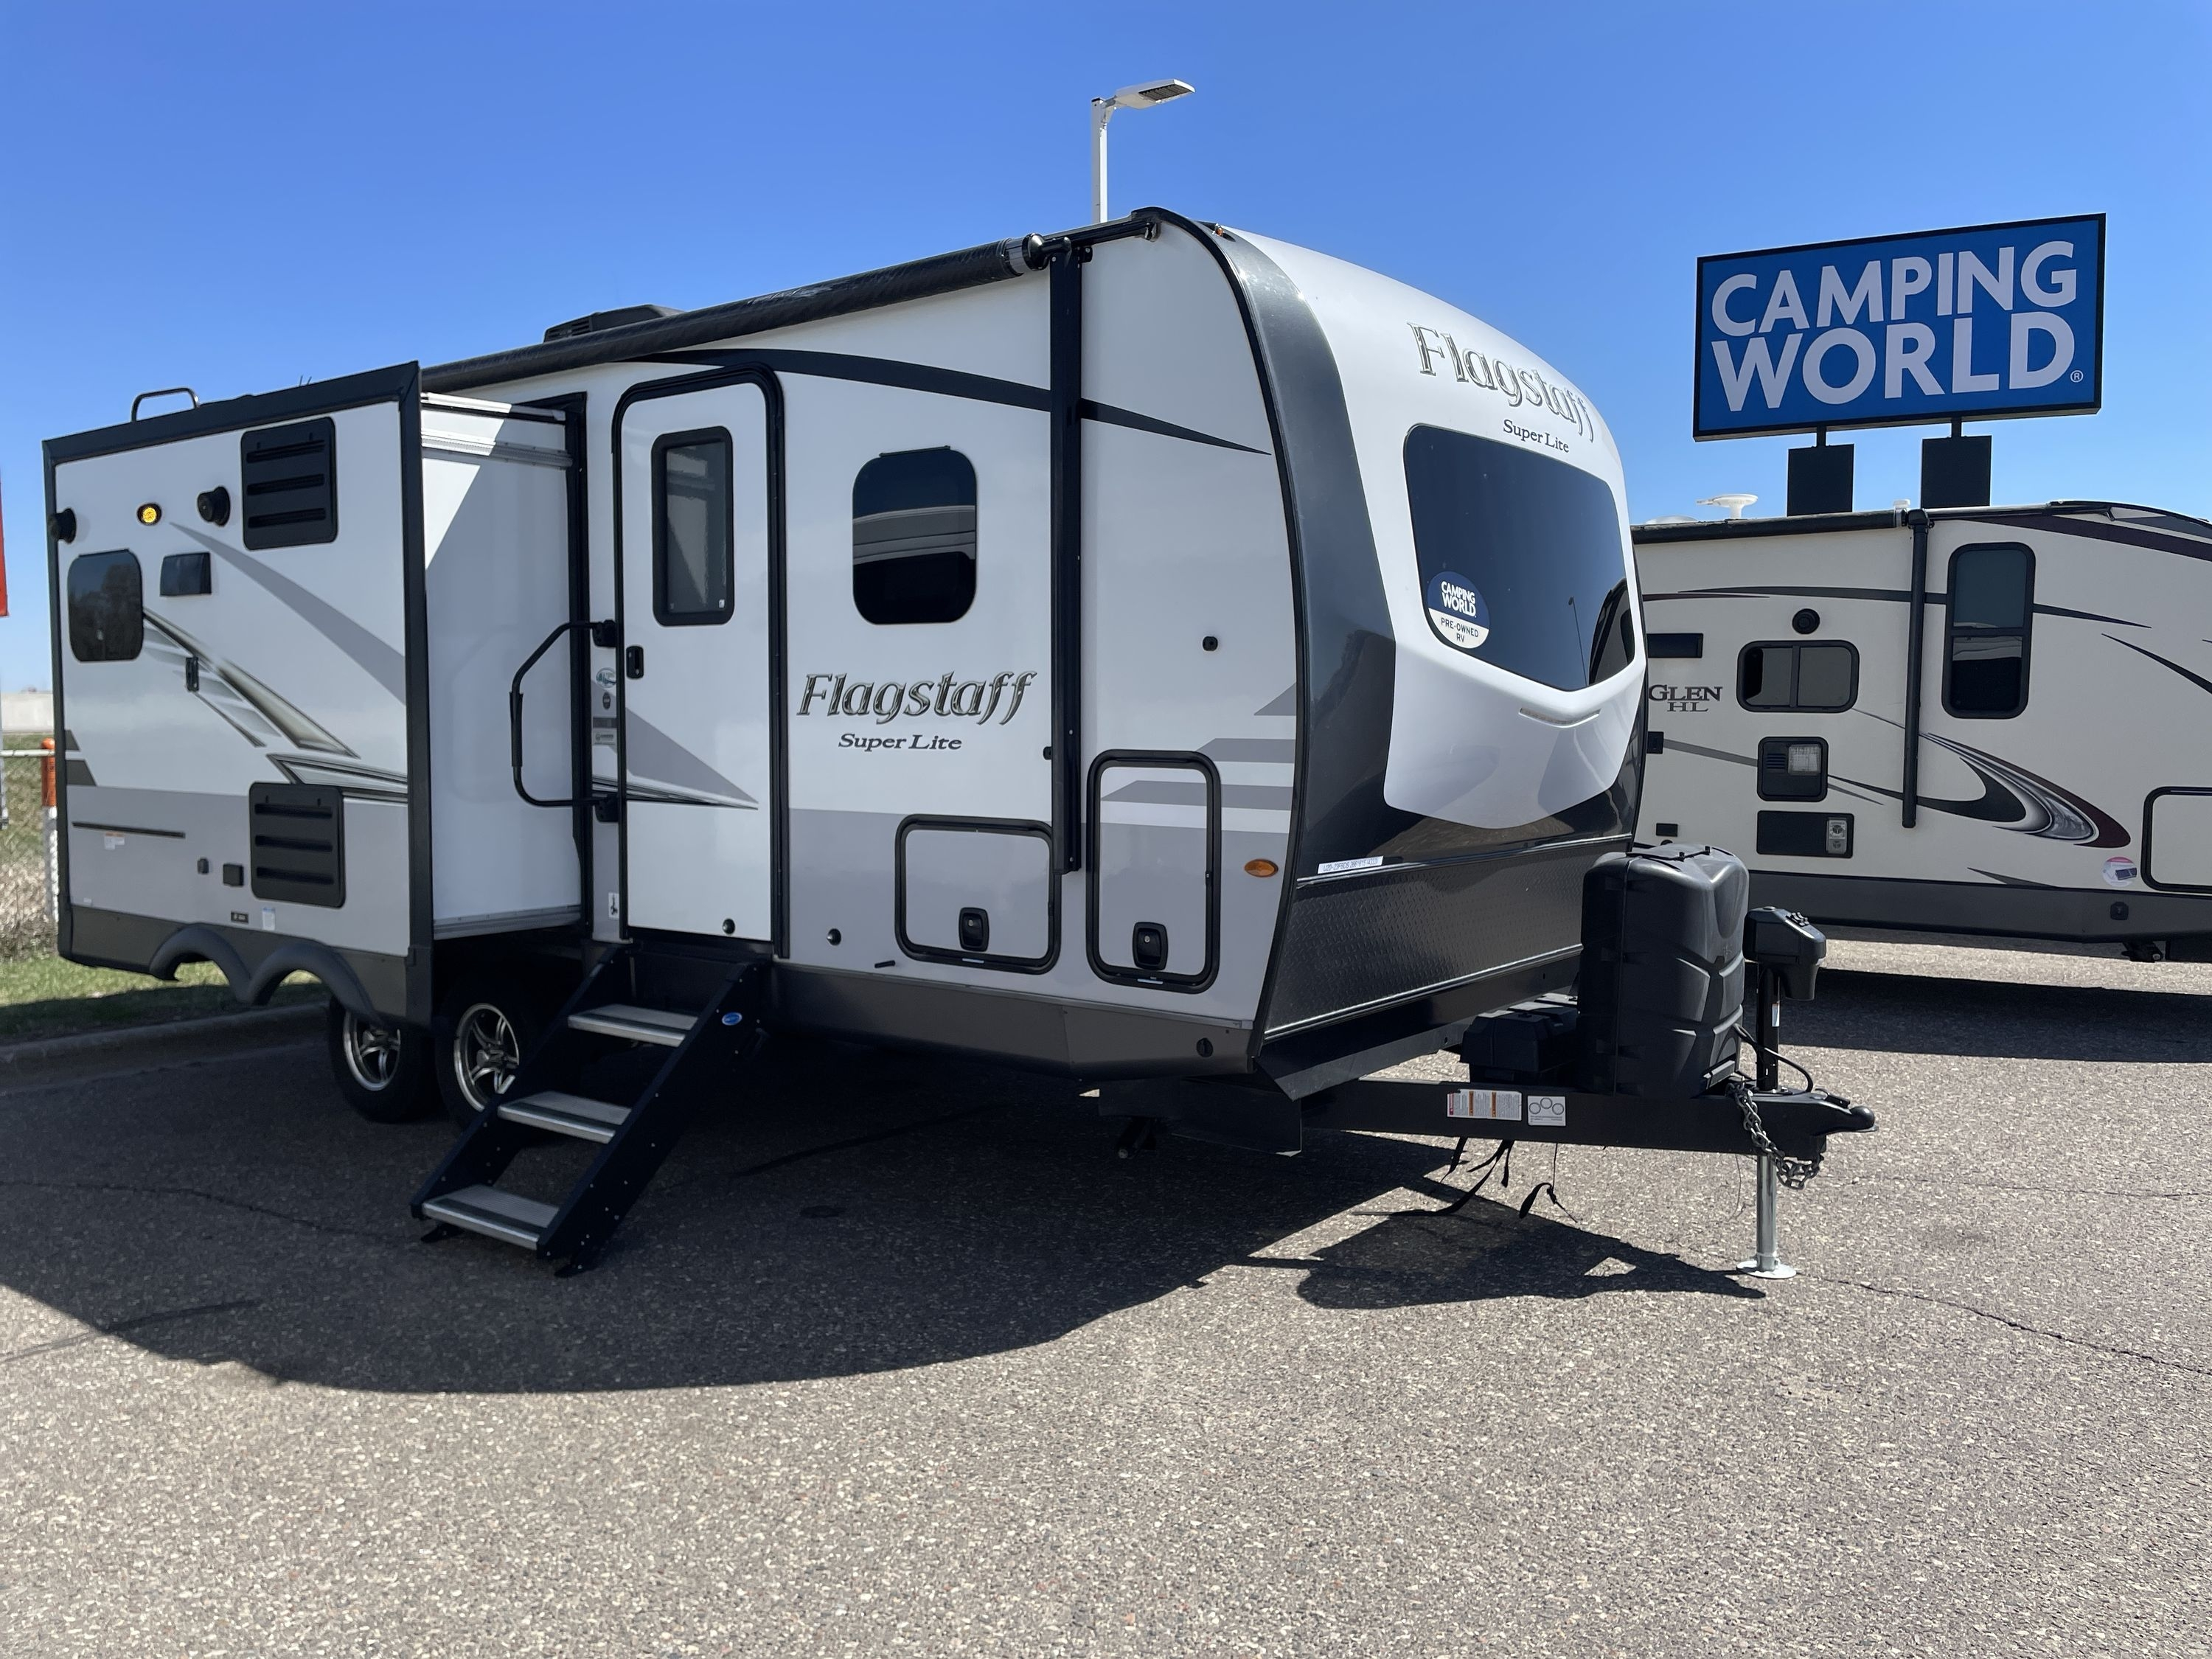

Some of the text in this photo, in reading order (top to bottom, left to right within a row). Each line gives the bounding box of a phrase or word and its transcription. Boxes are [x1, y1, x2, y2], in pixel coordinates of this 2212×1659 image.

[1711, 240, 2077, 337] CAMPING
[1711, 311, 2076, 412] WORLD
[1407, 322, 1594, 443] Flagstaff
[1503, 419, 1570, 453] Super Lite
[1441, 580, 1475, 605] CAMPING
[1441, 592, 1477, 617] WORLD
[1441, 617, 1479, 638] PRE-OWNED
[1456, 633, 1465, 643] RV
[796, 670, 1037, 726] Flagstaff
[1649, 684, 1723, 701] GLEN
[1667, 701, 1709, 712] HL
[838, 733, 962, 752] Super Lite
